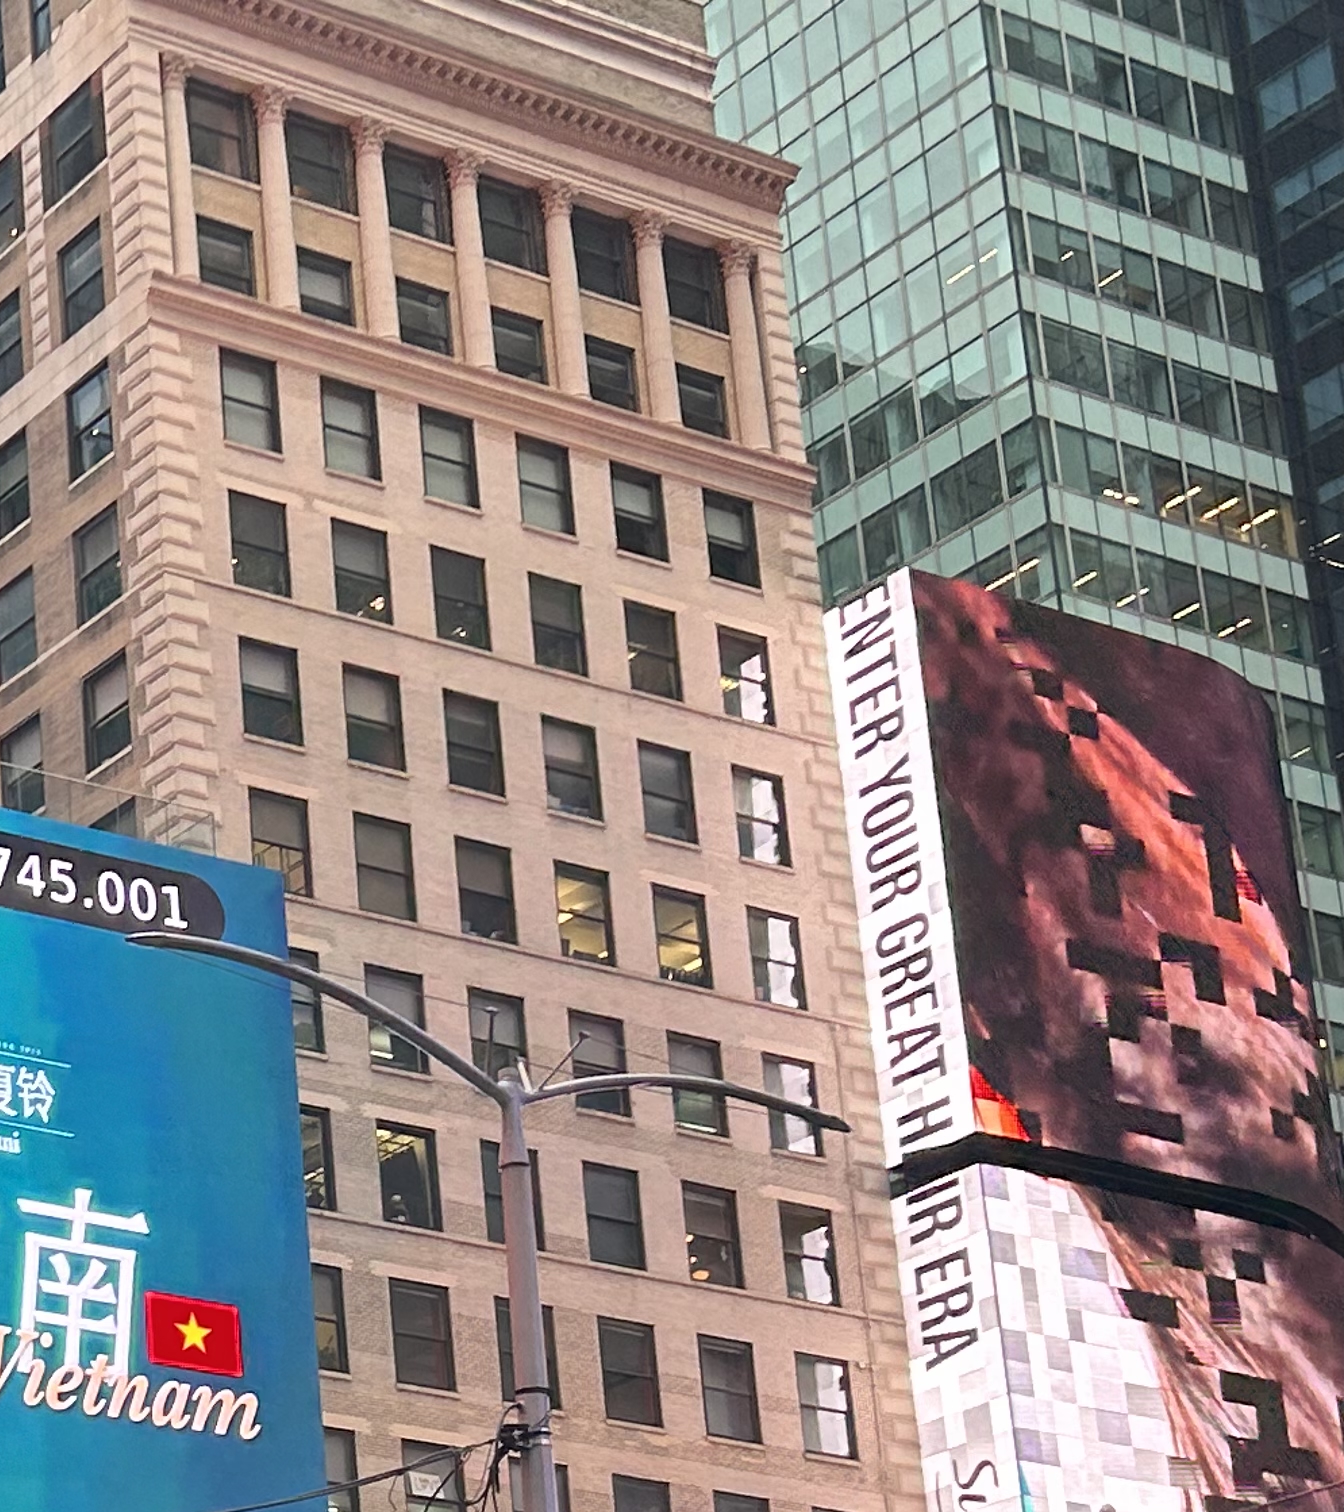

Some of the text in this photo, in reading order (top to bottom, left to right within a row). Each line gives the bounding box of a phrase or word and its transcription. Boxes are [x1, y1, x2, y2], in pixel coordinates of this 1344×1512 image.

[837, 582, 978, 1372] ENTER YOUR GREAT HIR ERA
